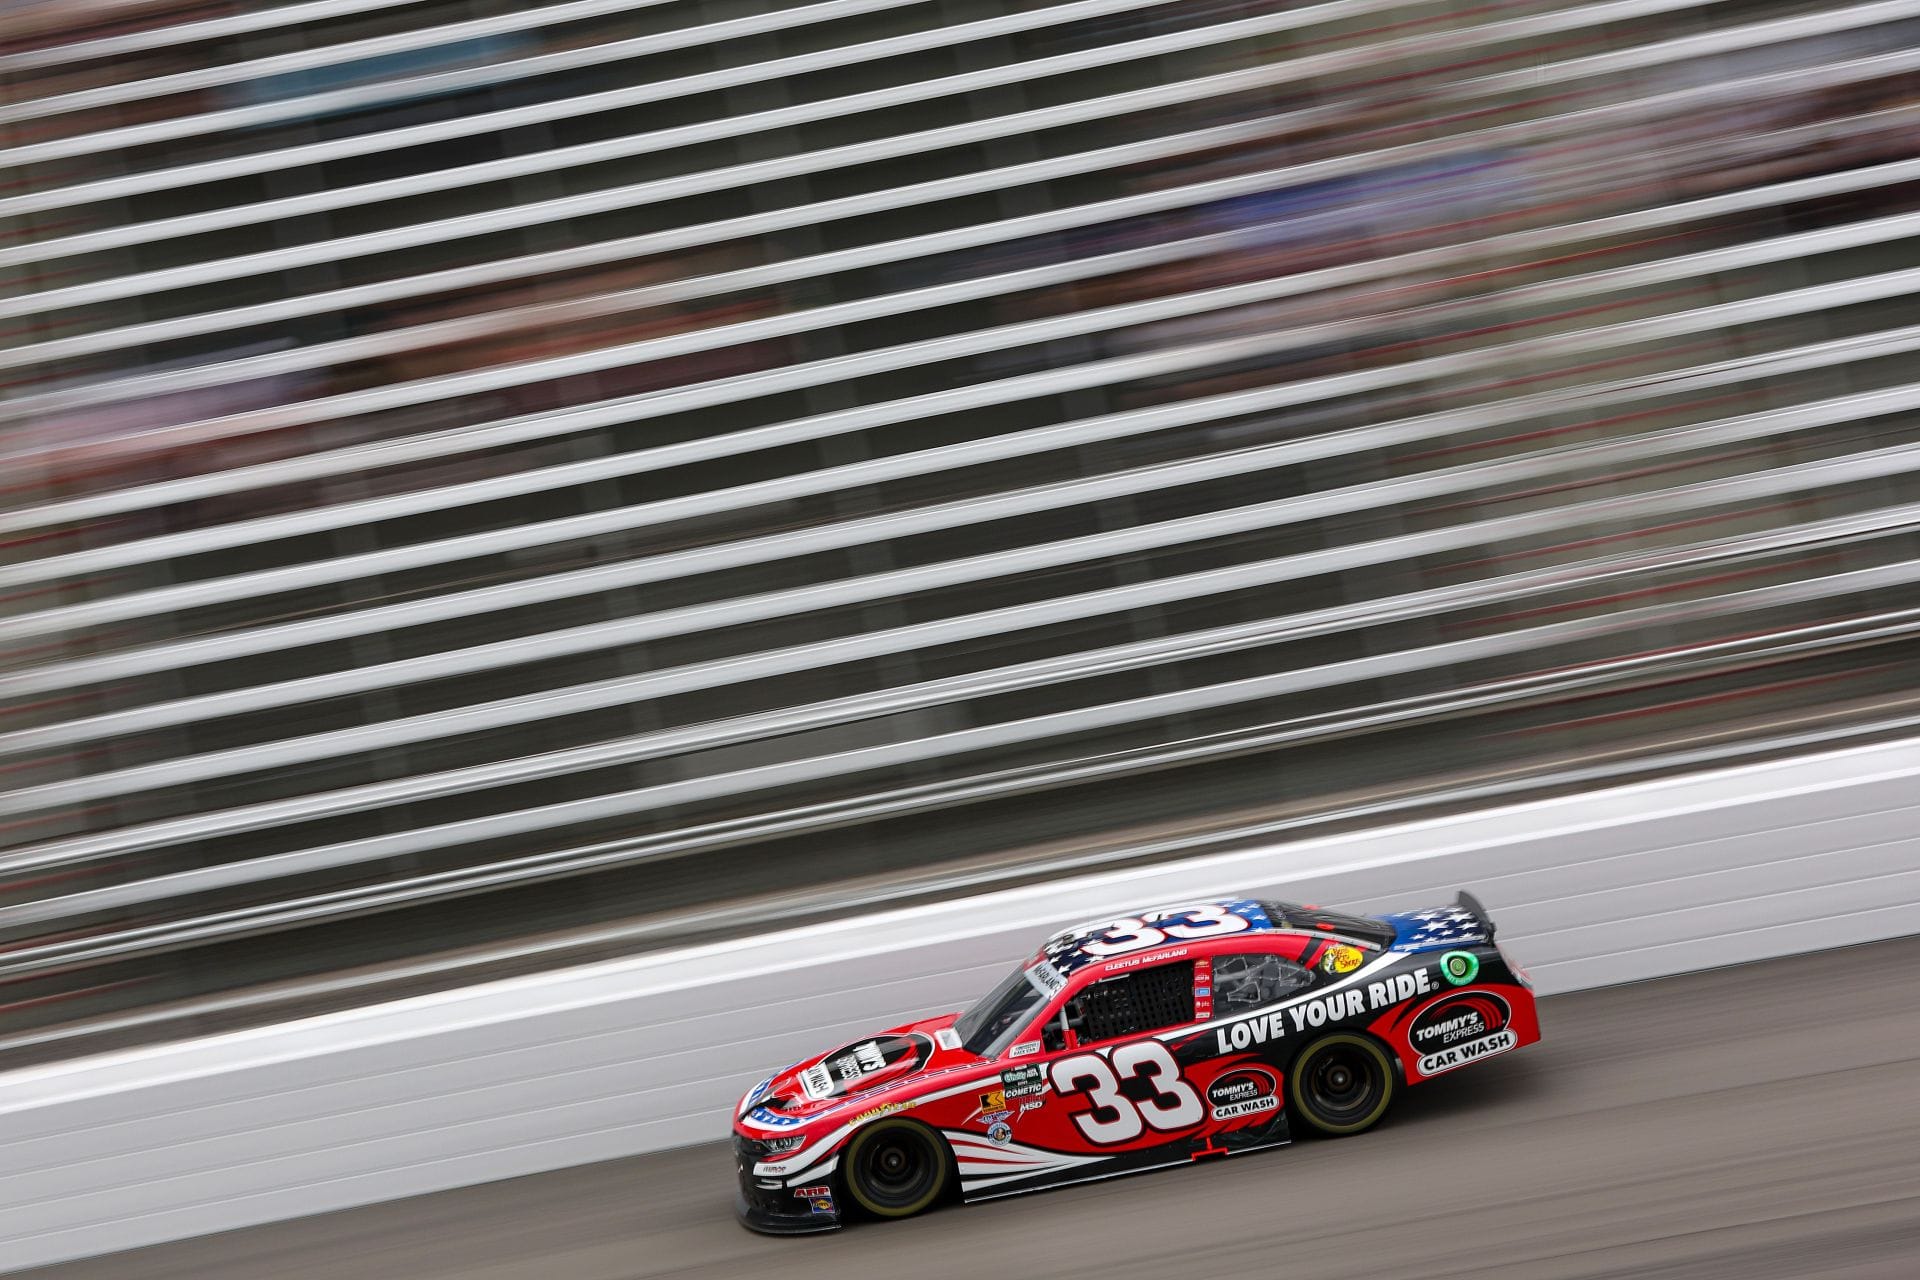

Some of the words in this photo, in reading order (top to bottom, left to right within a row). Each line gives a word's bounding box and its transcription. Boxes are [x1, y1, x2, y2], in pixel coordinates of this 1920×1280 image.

[1072, 904, 1250, 956] 33
[1104, 959, 1140, 971] CLEETUS
[1216, 1011, 1285, 1054] LOVE
[1289, 987, 1366, 1032] YOUR
[1367, 967, 1431, 1011] RIDE
[1416, 1011, 1478, 1041] TOMMY'S
[1443, 1020, 1485, 1044] EXPRESS
[1423, 1051, 1458, 1071] CAR
[1461, 1033, 1510, 1058] WASH
[1005, 1083, 1042, 1098] COMETIC
[1050, 1040, 1204, 1145] 33
[1212, 1081, 1254, 1098] TOMMY'S
[1229, 1088, 1258, 1101] EXPRESS
[1020, 1101, 1043, 1113] MSD
[1216, 1106, 1239, 1118] CAR
[1241, 1098, 1274, 1111] WASH
[794, 1186, 830, 1198] ARP
